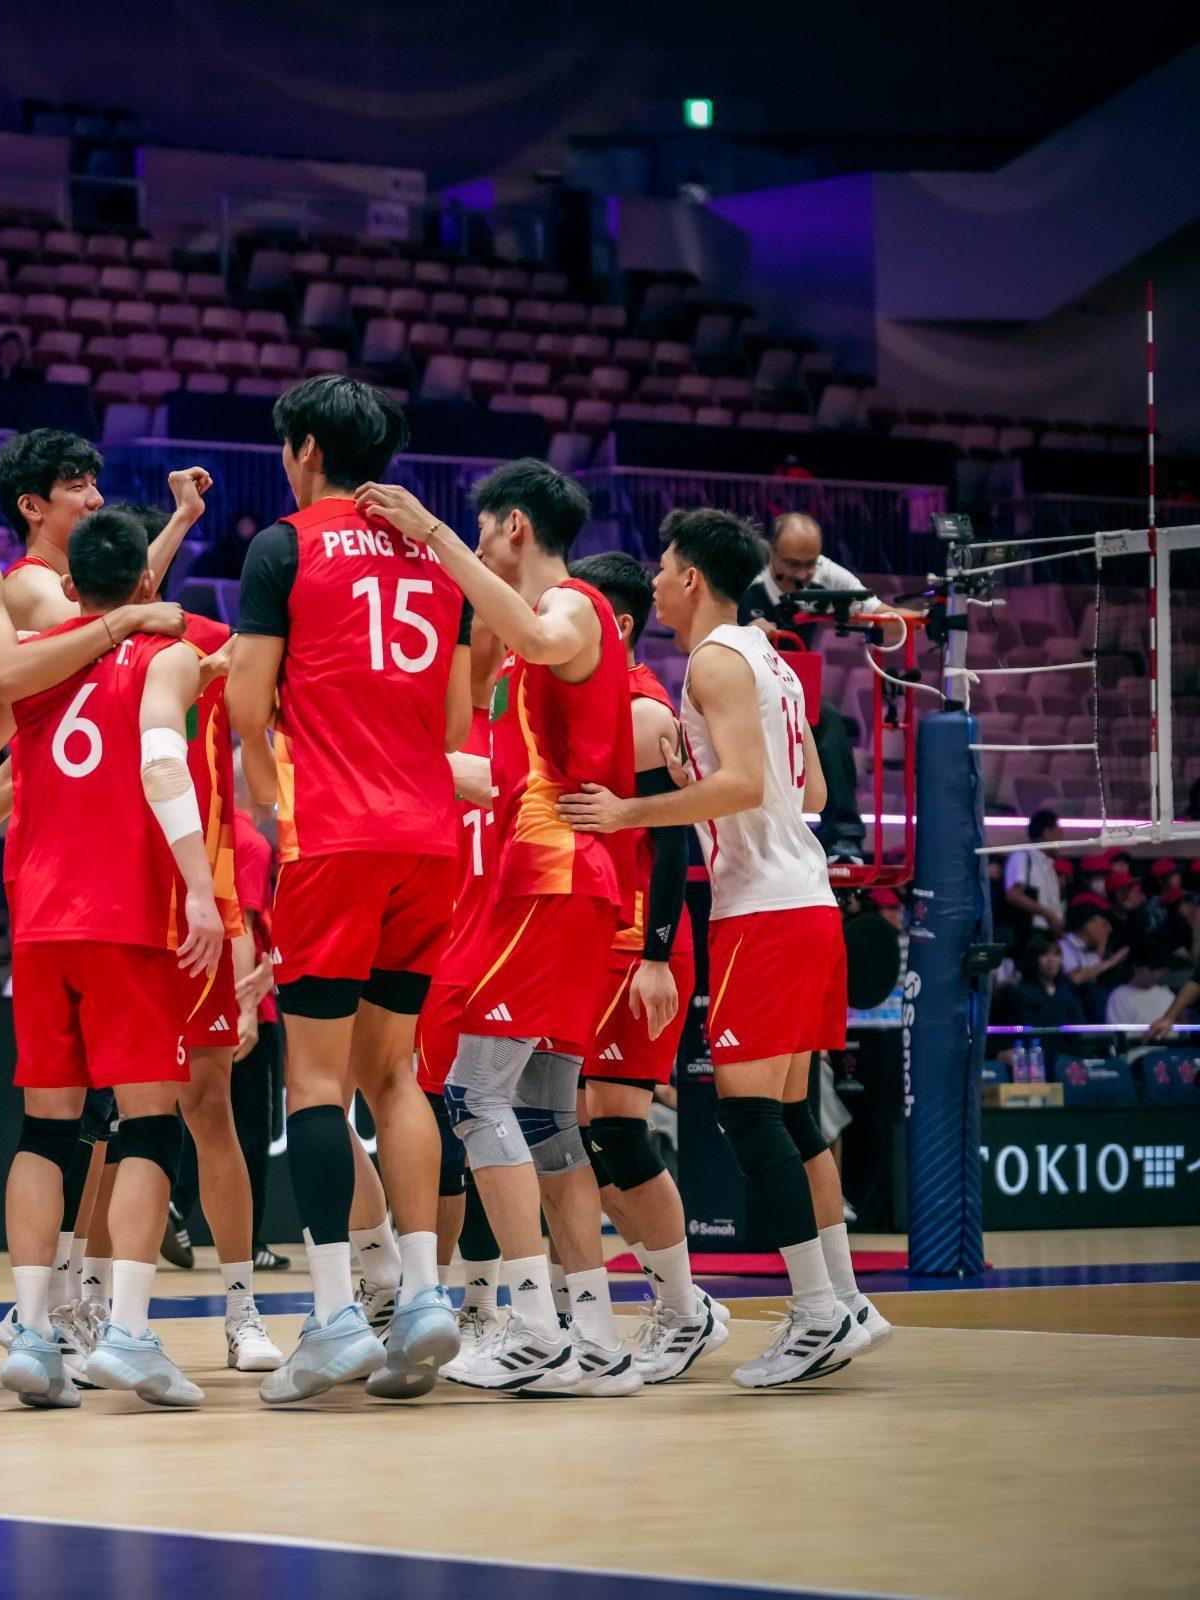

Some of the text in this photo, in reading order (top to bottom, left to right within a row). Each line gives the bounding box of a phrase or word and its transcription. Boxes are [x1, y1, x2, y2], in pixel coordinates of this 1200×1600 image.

[322, 529, 395, 559] PENG
[352, 576, 439, 673] 15
[51, 682, 103, 778] 6
[462, 809, 495, 876] 1
[177, 1035, 186, 1066] 6
[902, 1002, 915, 1118] Senoh
[979, 1142, 1130, 1196] OKIO
[700, 1222, 736, 1236] Senoh
